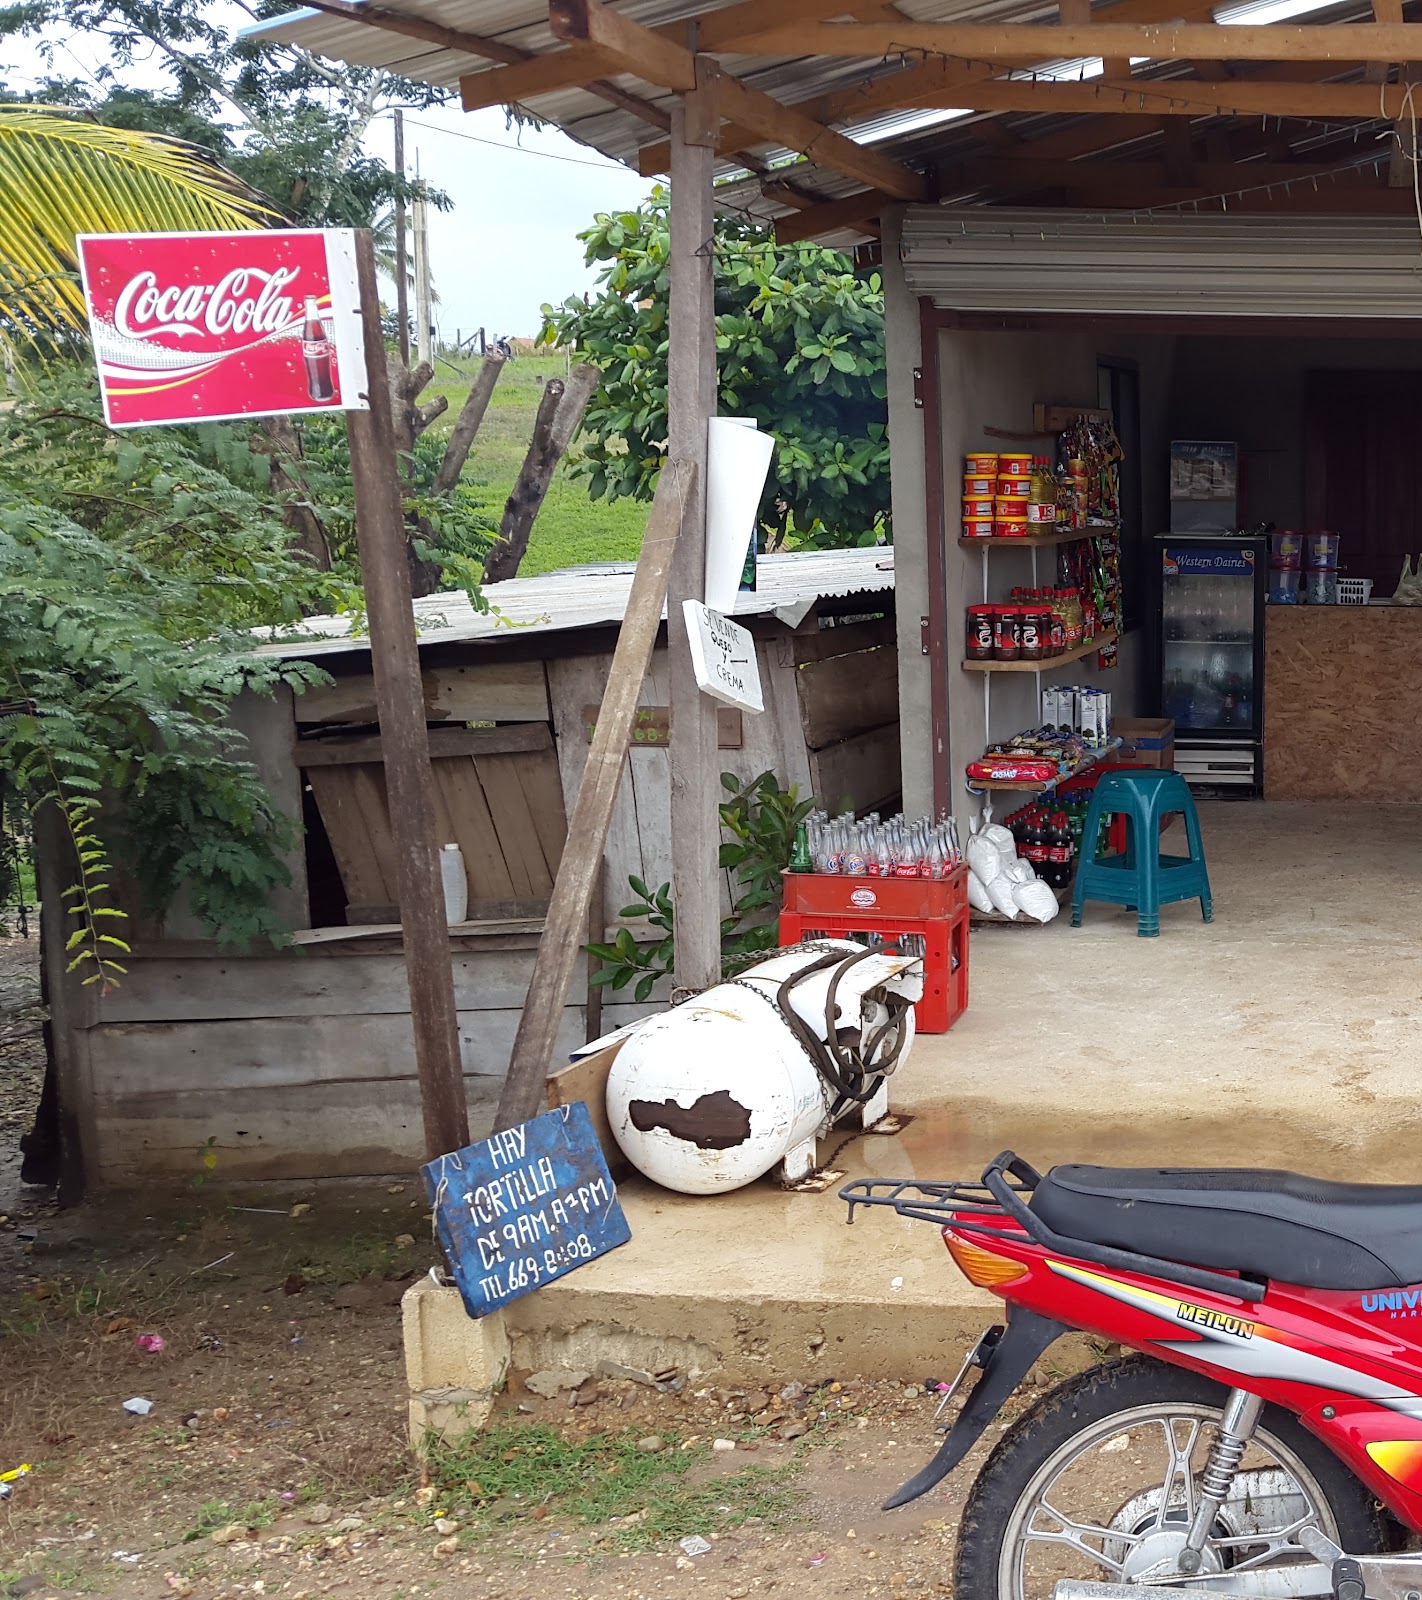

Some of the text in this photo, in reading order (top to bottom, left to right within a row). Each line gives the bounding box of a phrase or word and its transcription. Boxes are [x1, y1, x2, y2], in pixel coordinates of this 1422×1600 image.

[114, 265, 300, 340] Coca-Cola
[1175, 554, 1247, 569] Western Dairies
[717, 664, 745, 693] CREMA
[487, 1124, 526, 1169] HAY
[477, 1229, 505, 1270] DE
[1177, 1302, 1255, 1339] MEILUN
